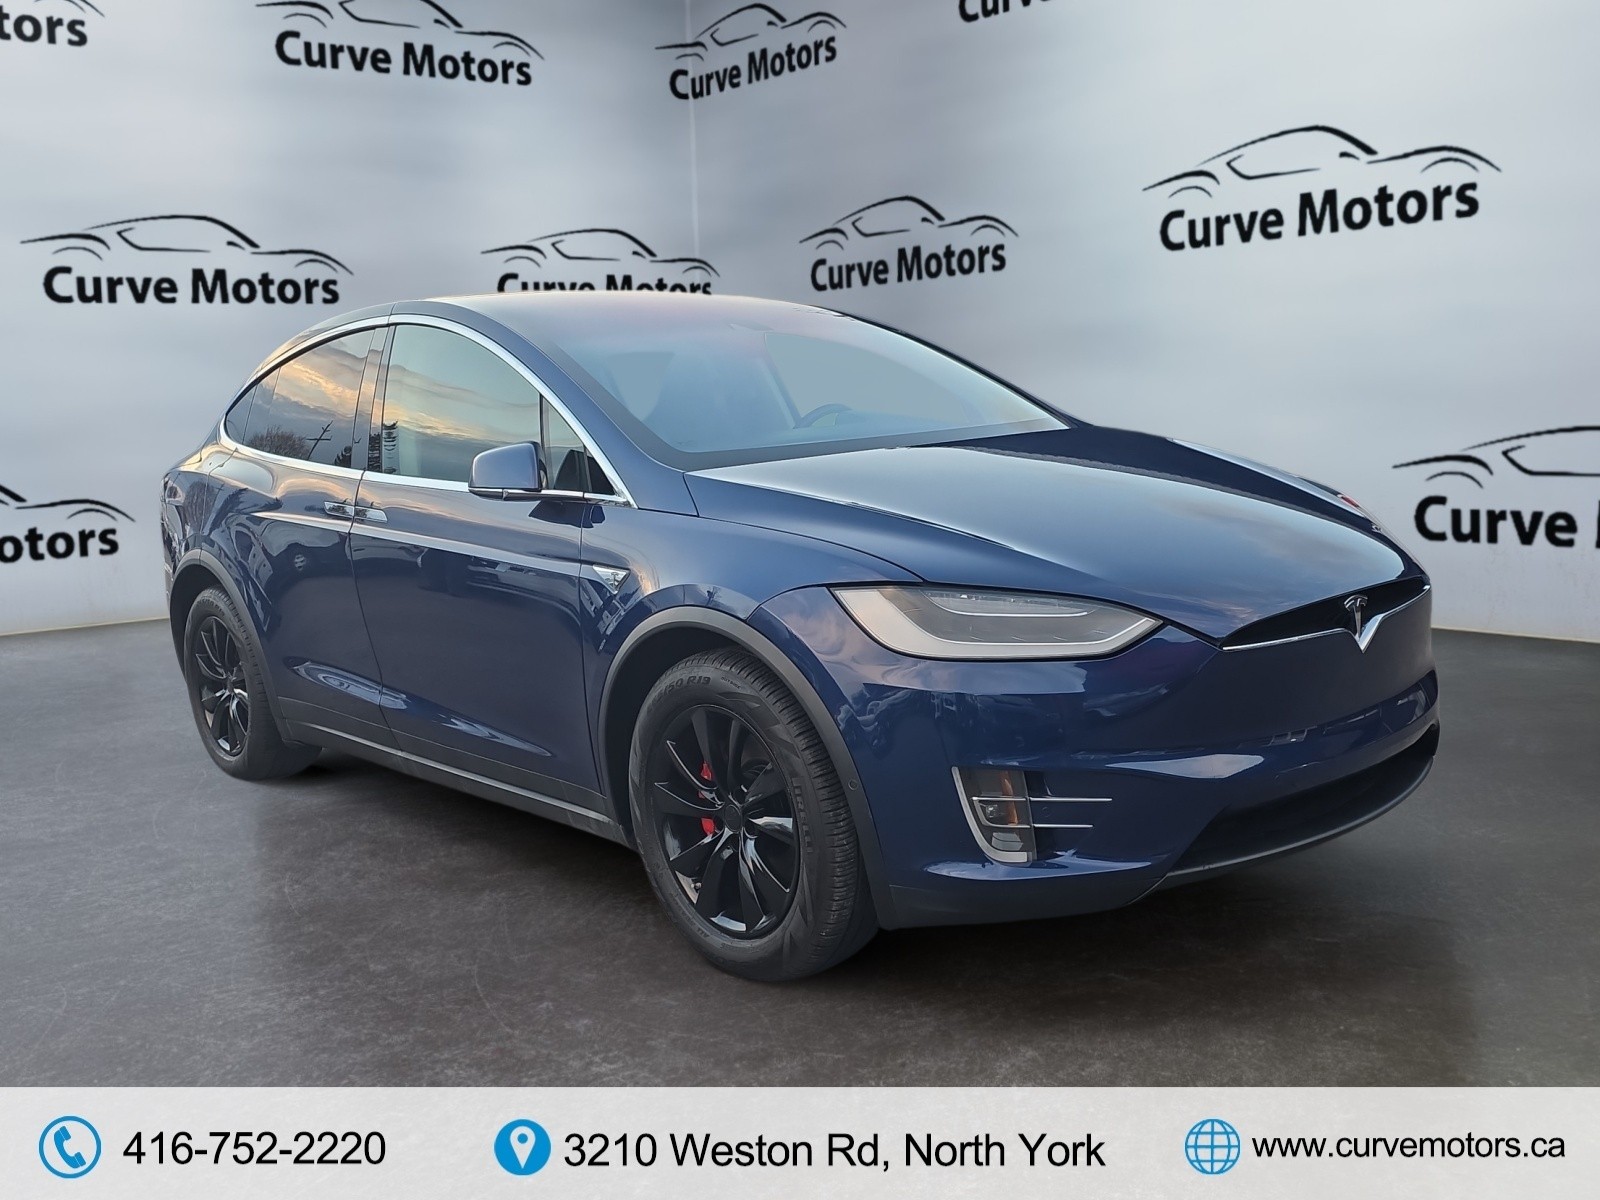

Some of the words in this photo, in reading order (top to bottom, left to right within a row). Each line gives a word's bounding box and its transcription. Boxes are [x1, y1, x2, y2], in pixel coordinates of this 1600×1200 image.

[275, 31, 391, 73] Curve
[403, 42, 531, 85] Motors
[669, 65, 741, 100] Curve
[748, 36, 836, 84] Motors
[1160, 209, 1284, 251] Curve
[1298, 183, 1478, 236] Motors
[43, 266, 178, 303] Curve
[192, 269, 339, 304] Motors
[811, 258, 889, 291] Curve
[897, 244, 1006, 283] Motors
[1414, 496, 1577, 547] Curve
